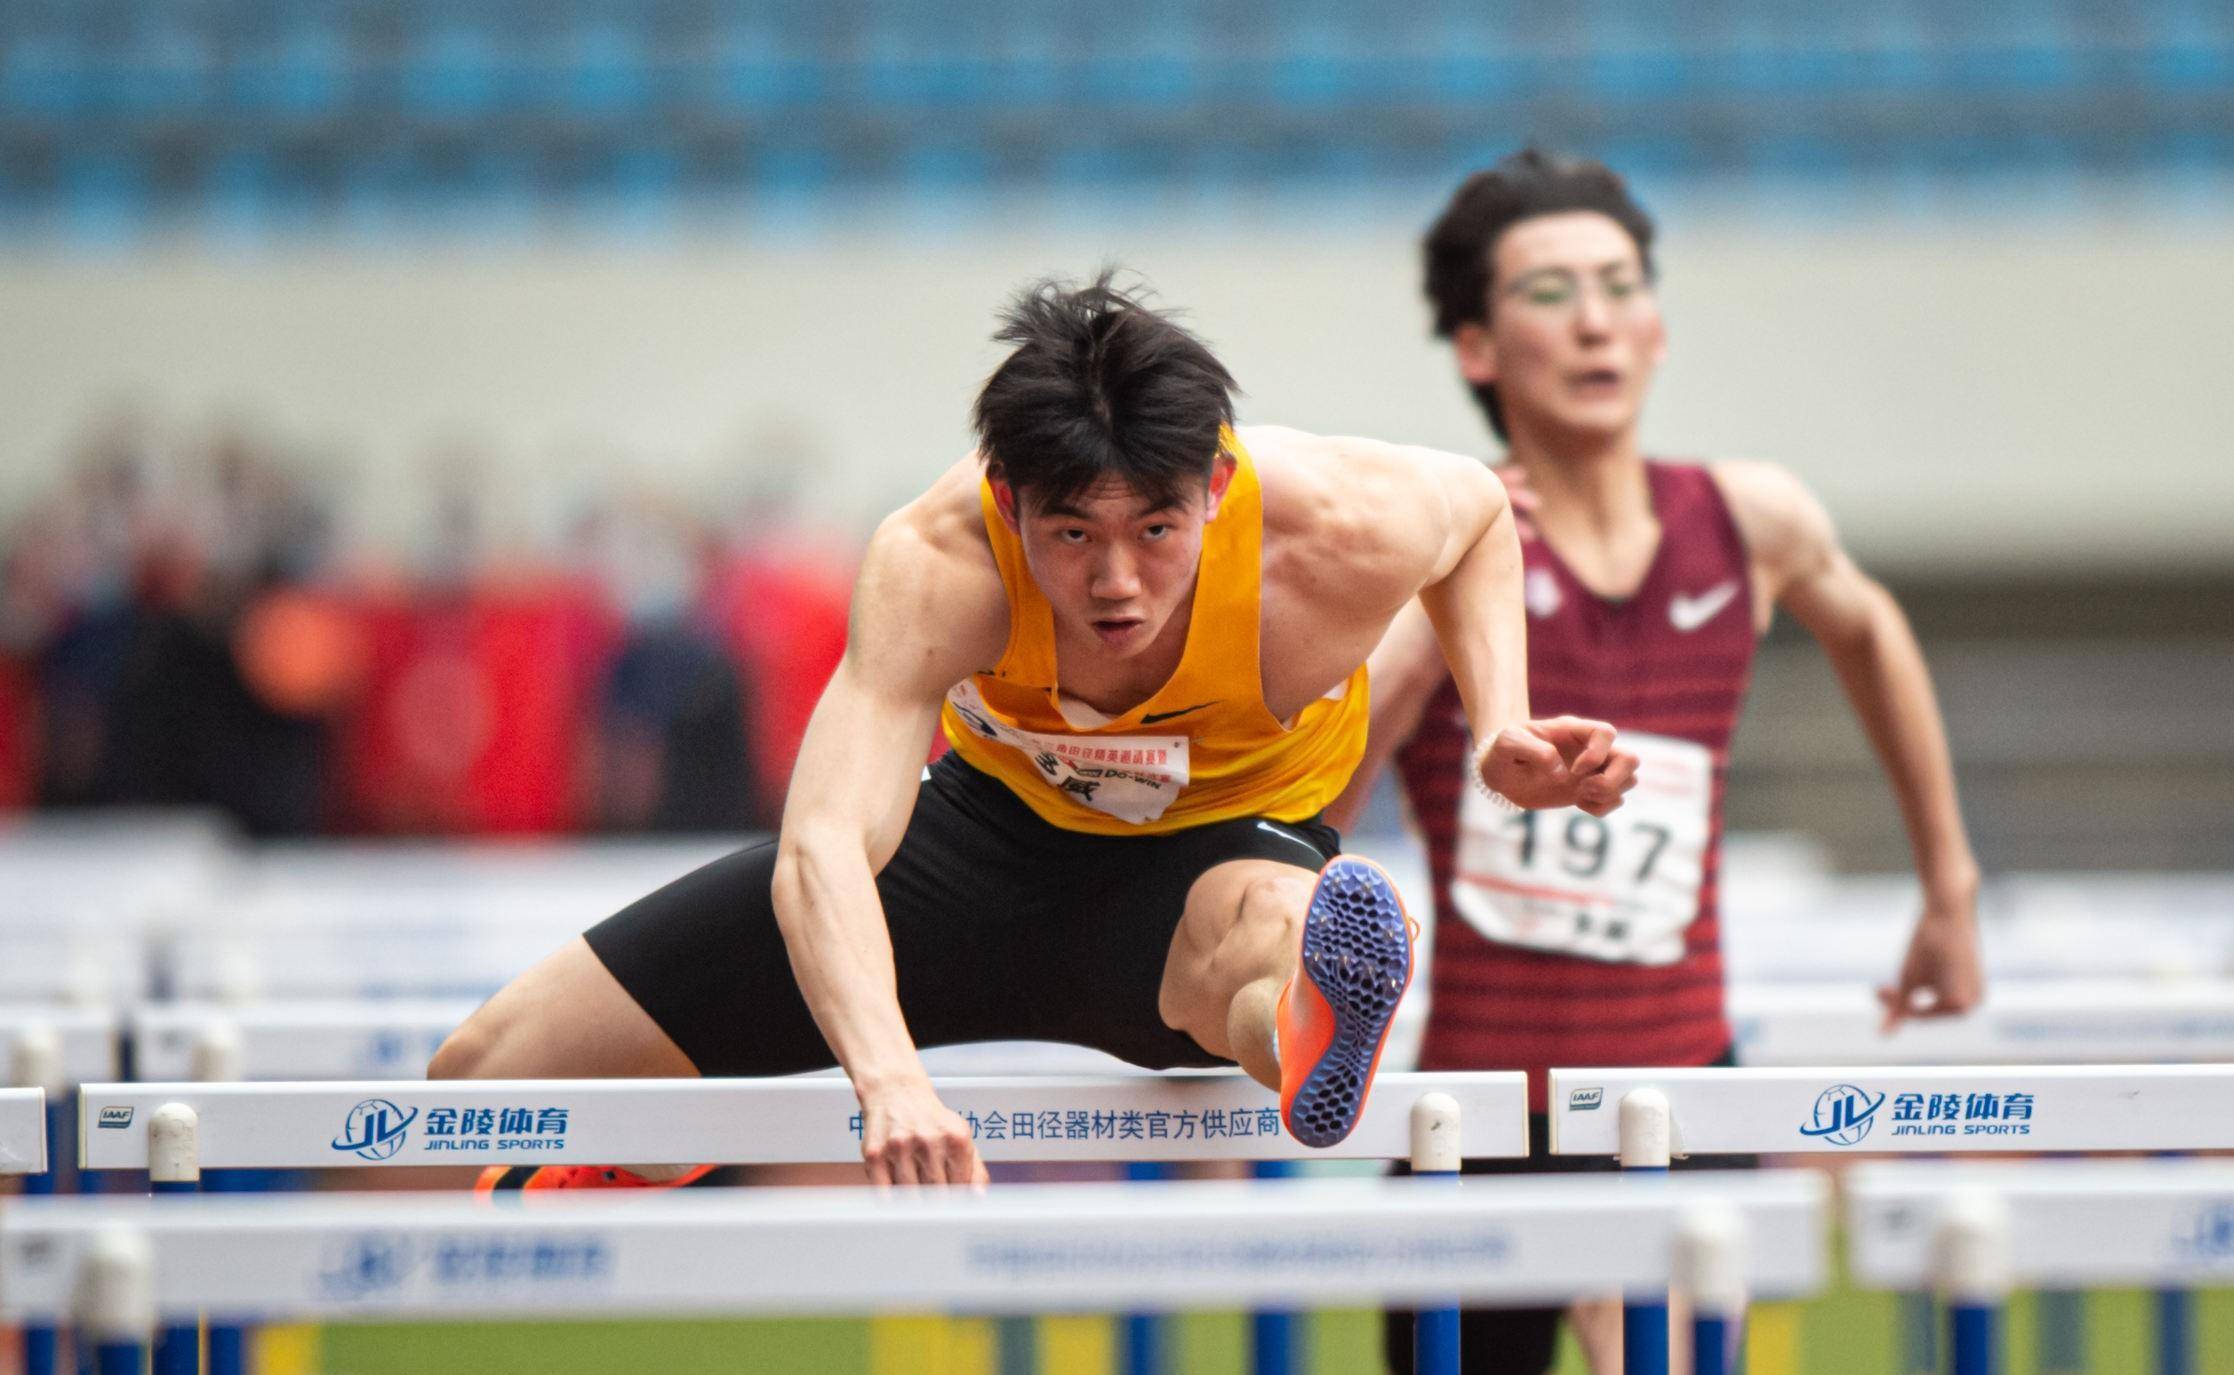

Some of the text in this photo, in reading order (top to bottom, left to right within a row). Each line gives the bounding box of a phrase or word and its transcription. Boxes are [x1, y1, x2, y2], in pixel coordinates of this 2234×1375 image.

[1505, 810, 1672, 883] 197
[1891, 1093, 2034, 1121] 金陵体育
[424, 1107, 569, 1136] 金陵体育
[1964, 1124, 2030, 1135] SPORTS
[497, 1139, 564, 1150] SPORTS
